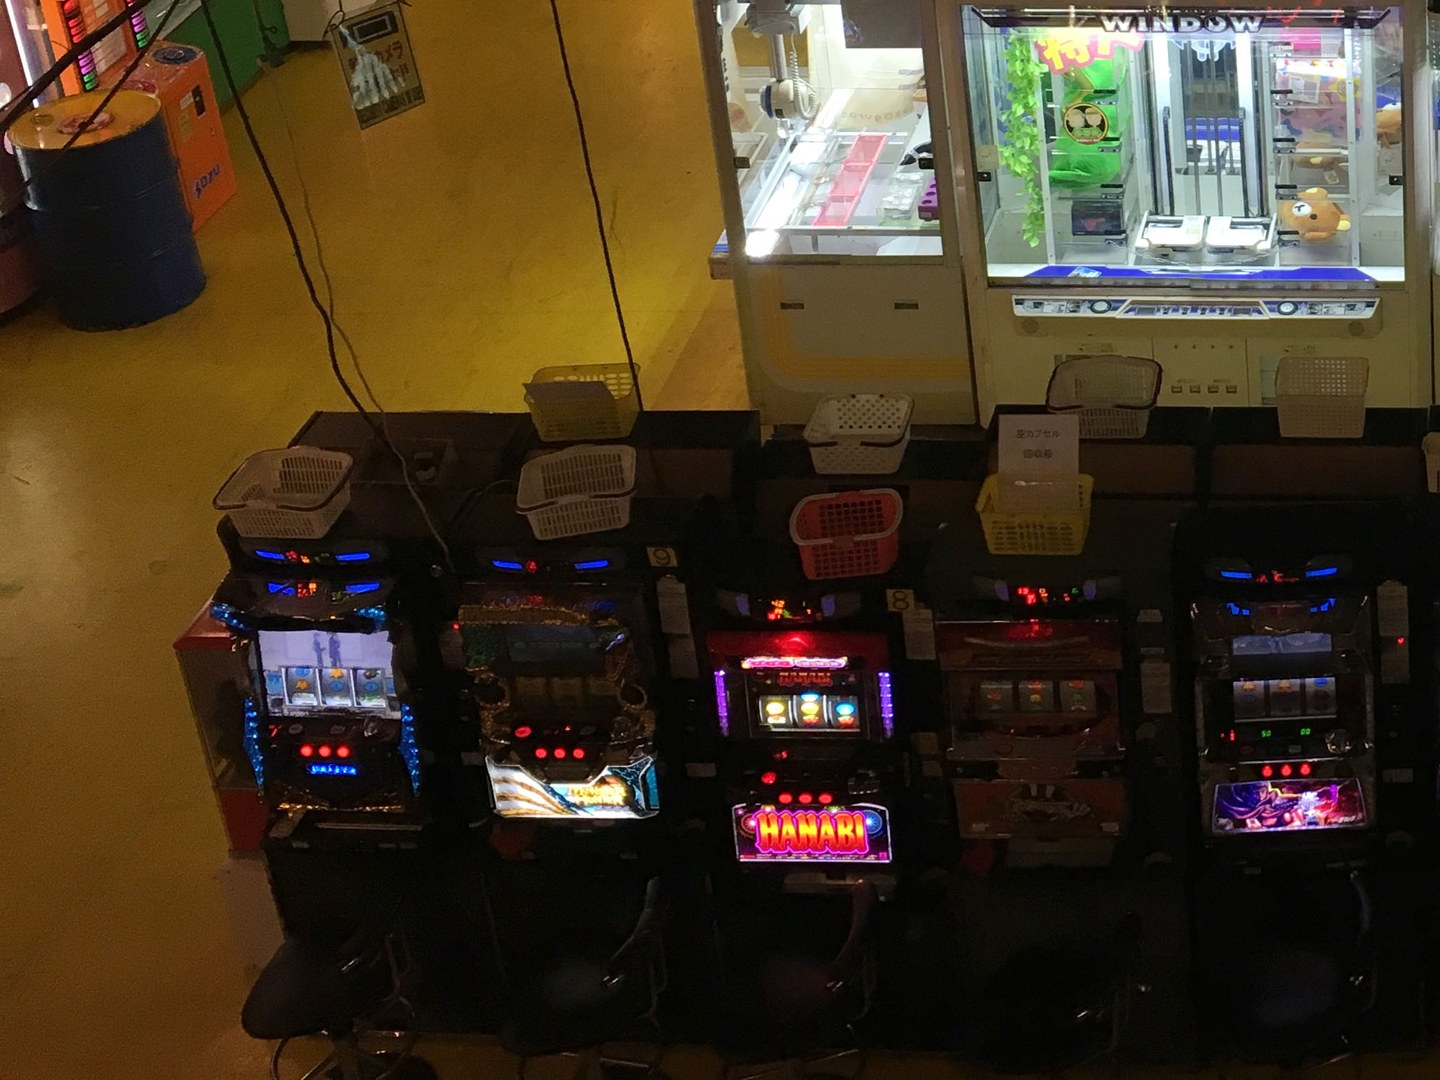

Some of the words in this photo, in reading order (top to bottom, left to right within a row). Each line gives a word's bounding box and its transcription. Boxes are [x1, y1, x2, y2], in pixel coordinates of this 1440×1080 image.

[1101, 15, 1264, 33] WINDOW
[892, 590, 910, 611] 8
[755, 810, 868, 854] HANABI
